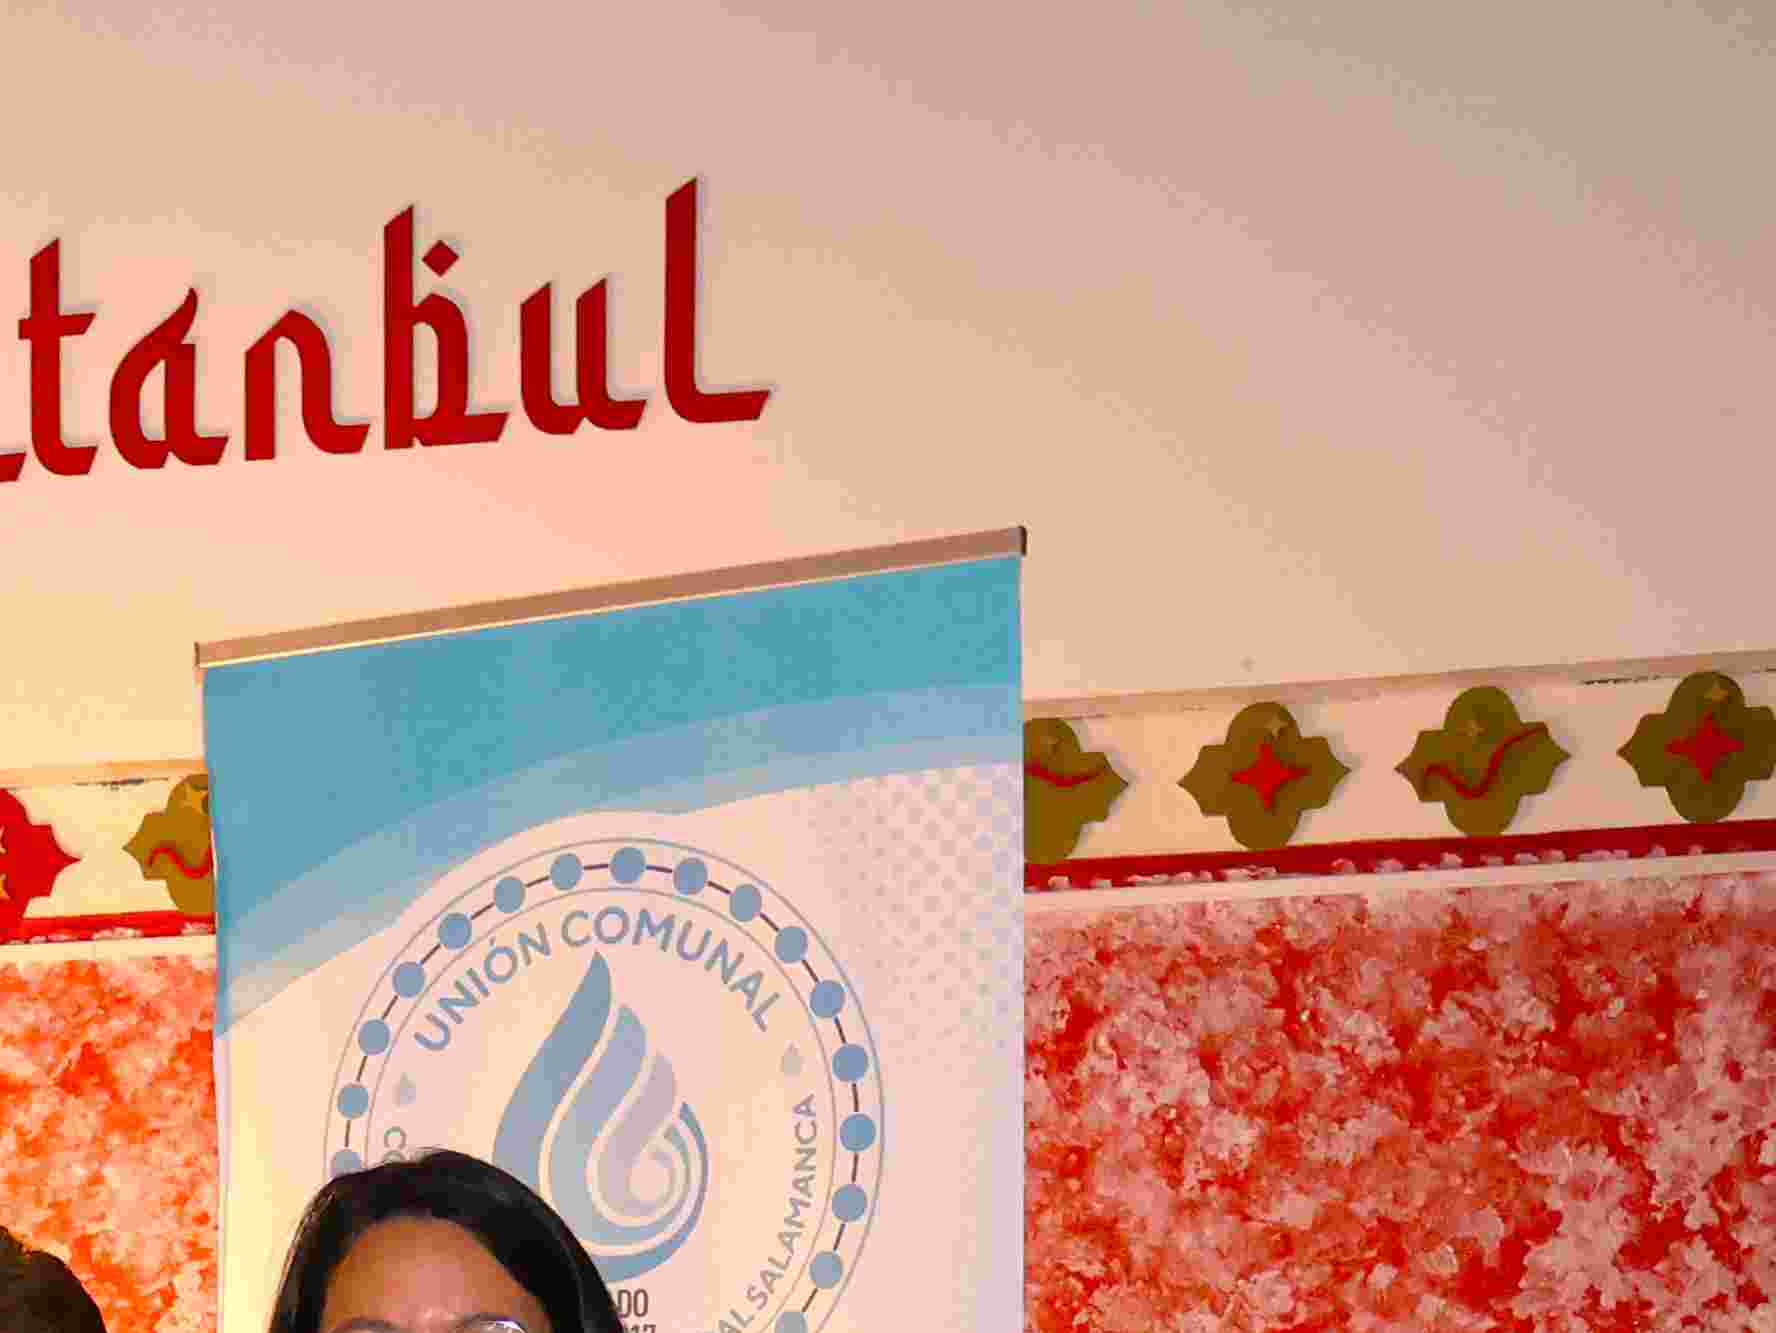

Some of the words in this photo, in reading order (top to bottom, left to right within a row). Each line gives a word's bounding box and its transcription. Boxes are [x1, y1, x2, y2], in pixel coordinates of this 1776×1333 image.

[413, 922, 552, 1051] UNIÓN
[561, 905, 780, 1033] COMUNAL
[744, 1094, 818, 1310] SALAMANCA
[616, 1288, 649, 1318] DO
